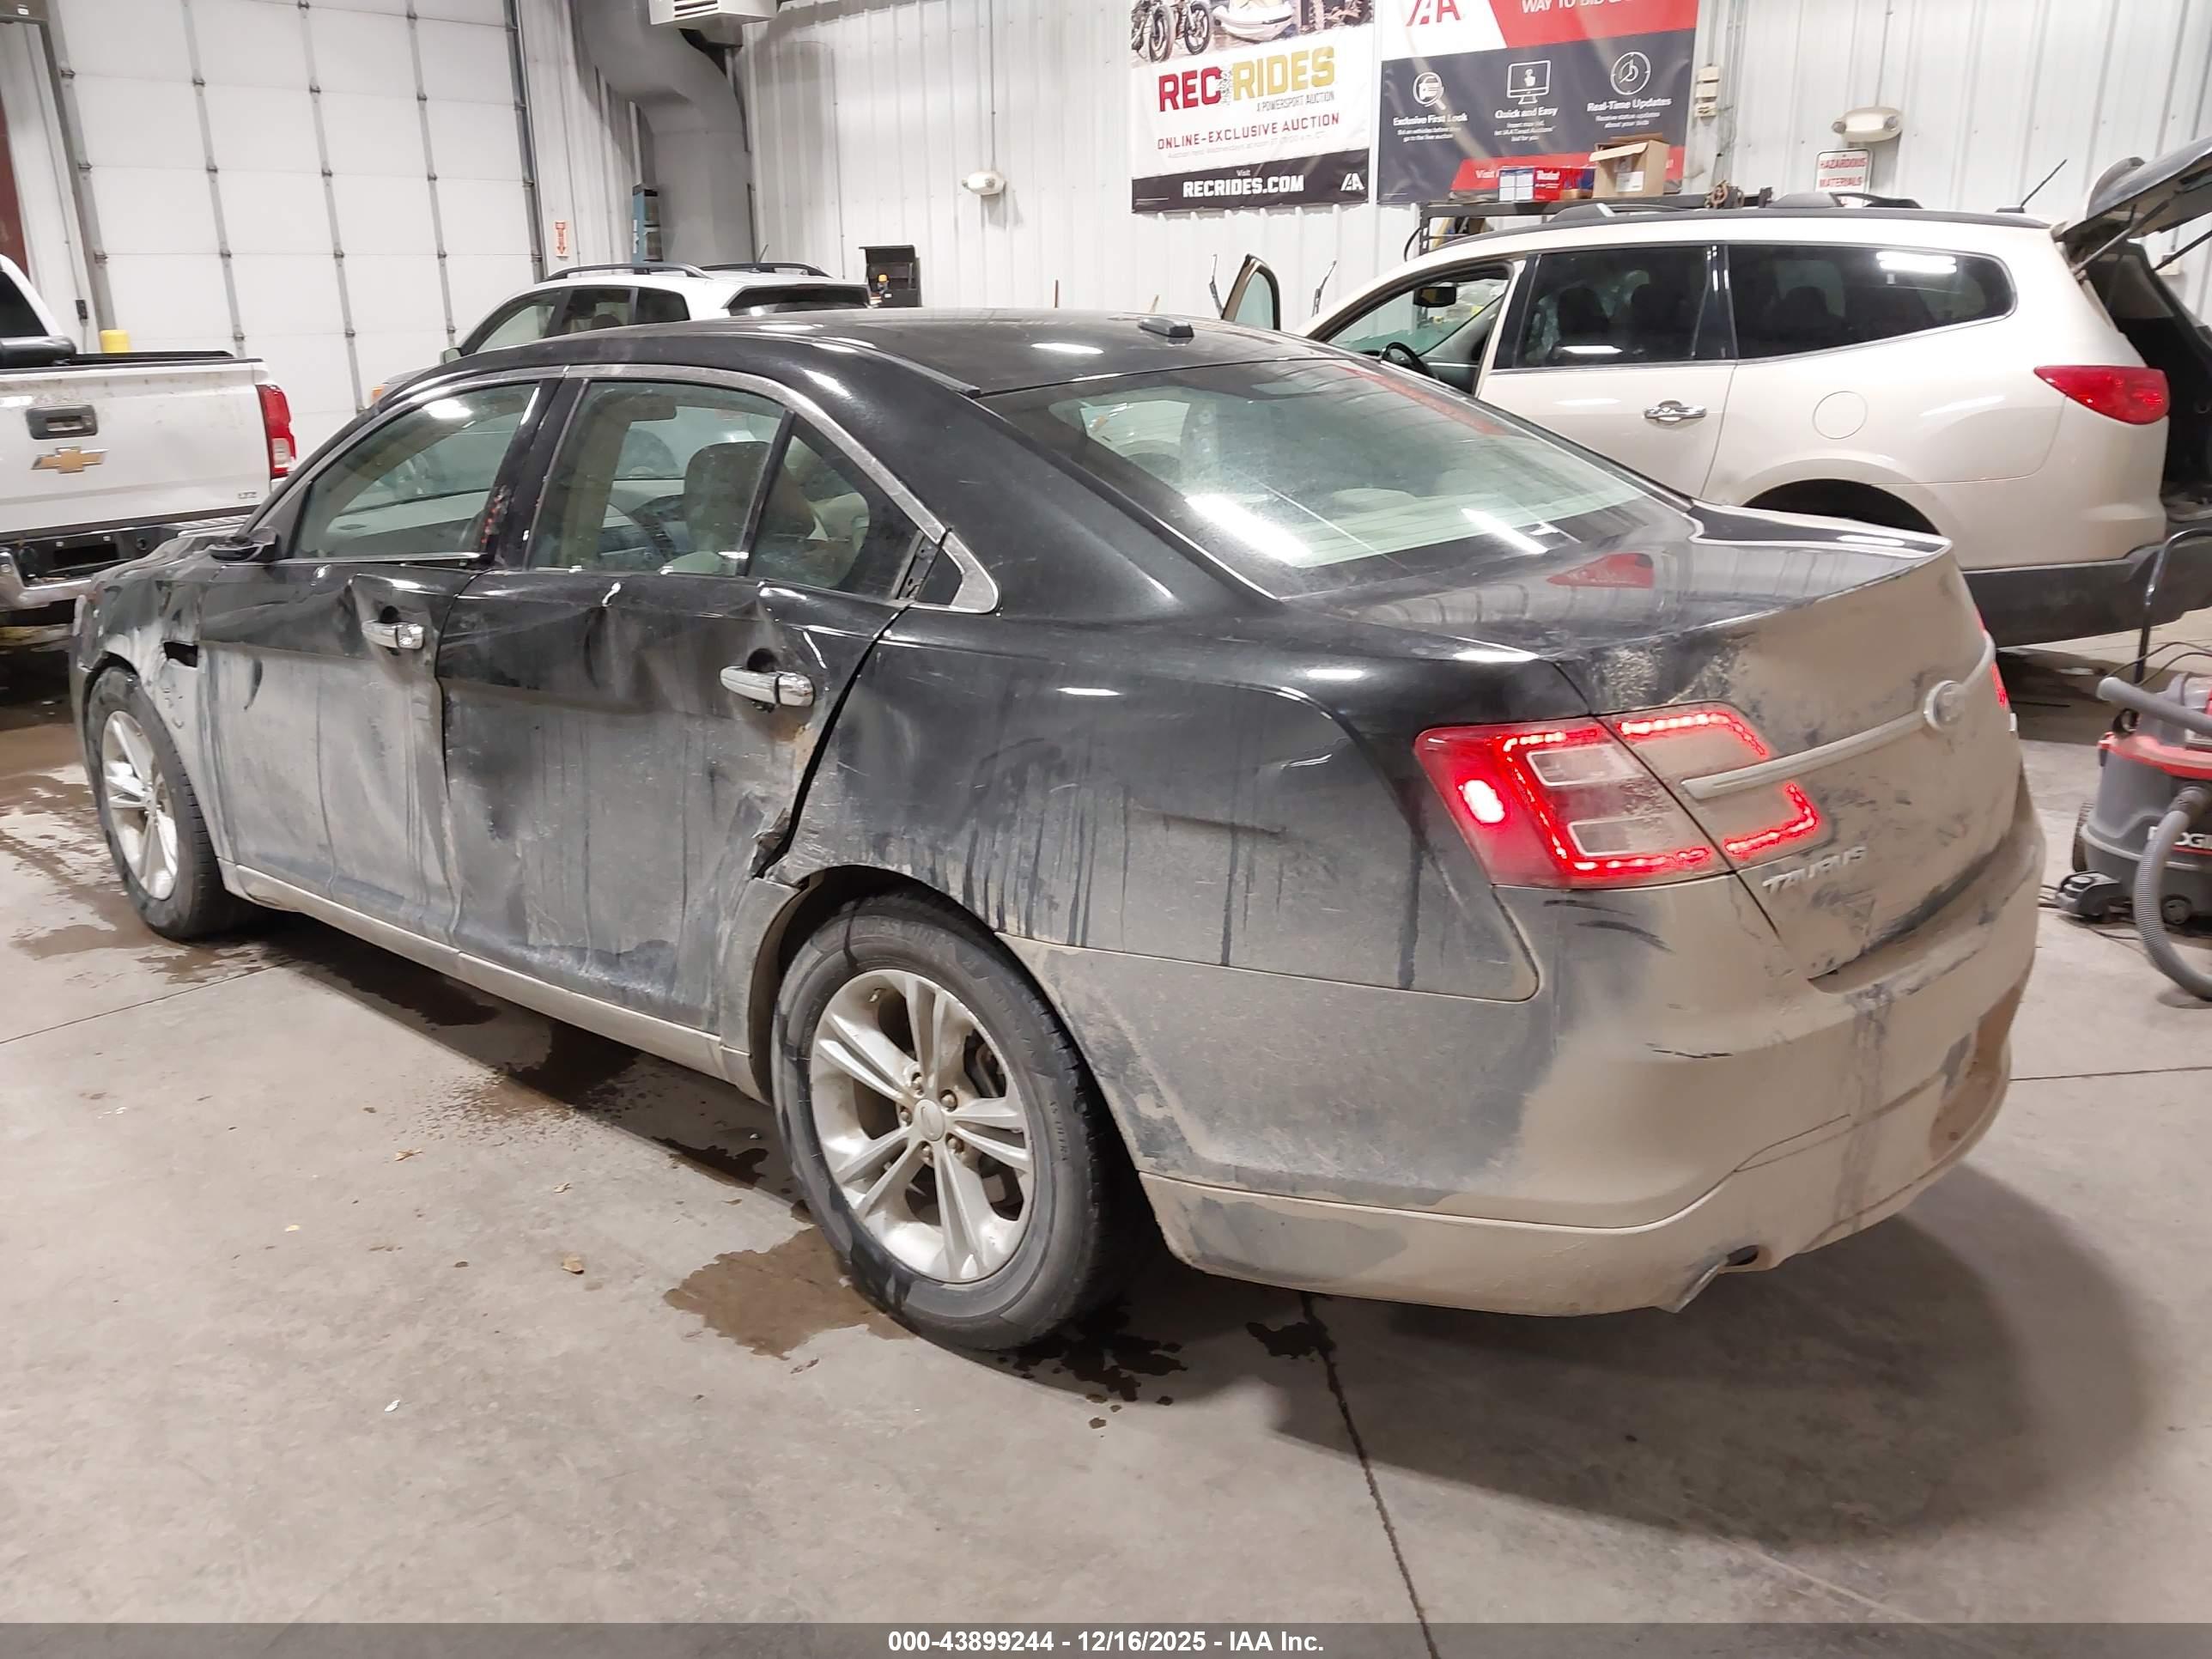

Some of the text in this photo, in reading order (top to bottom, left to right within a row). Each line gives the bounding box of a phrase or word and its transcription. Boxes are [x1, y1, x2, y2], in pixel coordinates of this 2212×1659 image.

[1158, 46, 1336, 112] REC RIDES
[1306, 91, 1335, 104] AUCTION
[1587, 97, 1673, 112] Real-Time Updates
[1393, 112, 1468, 126] Exclusive First Look
[1494, 106, 1559, 119] Quick and Easy
[1158, 123, 1279, 150] ONLINE-EXCLUSIVE
[1281, 112, 1340, 131] AUCTION
[1182, 174, 1305, 198] RECRIDES.COM
